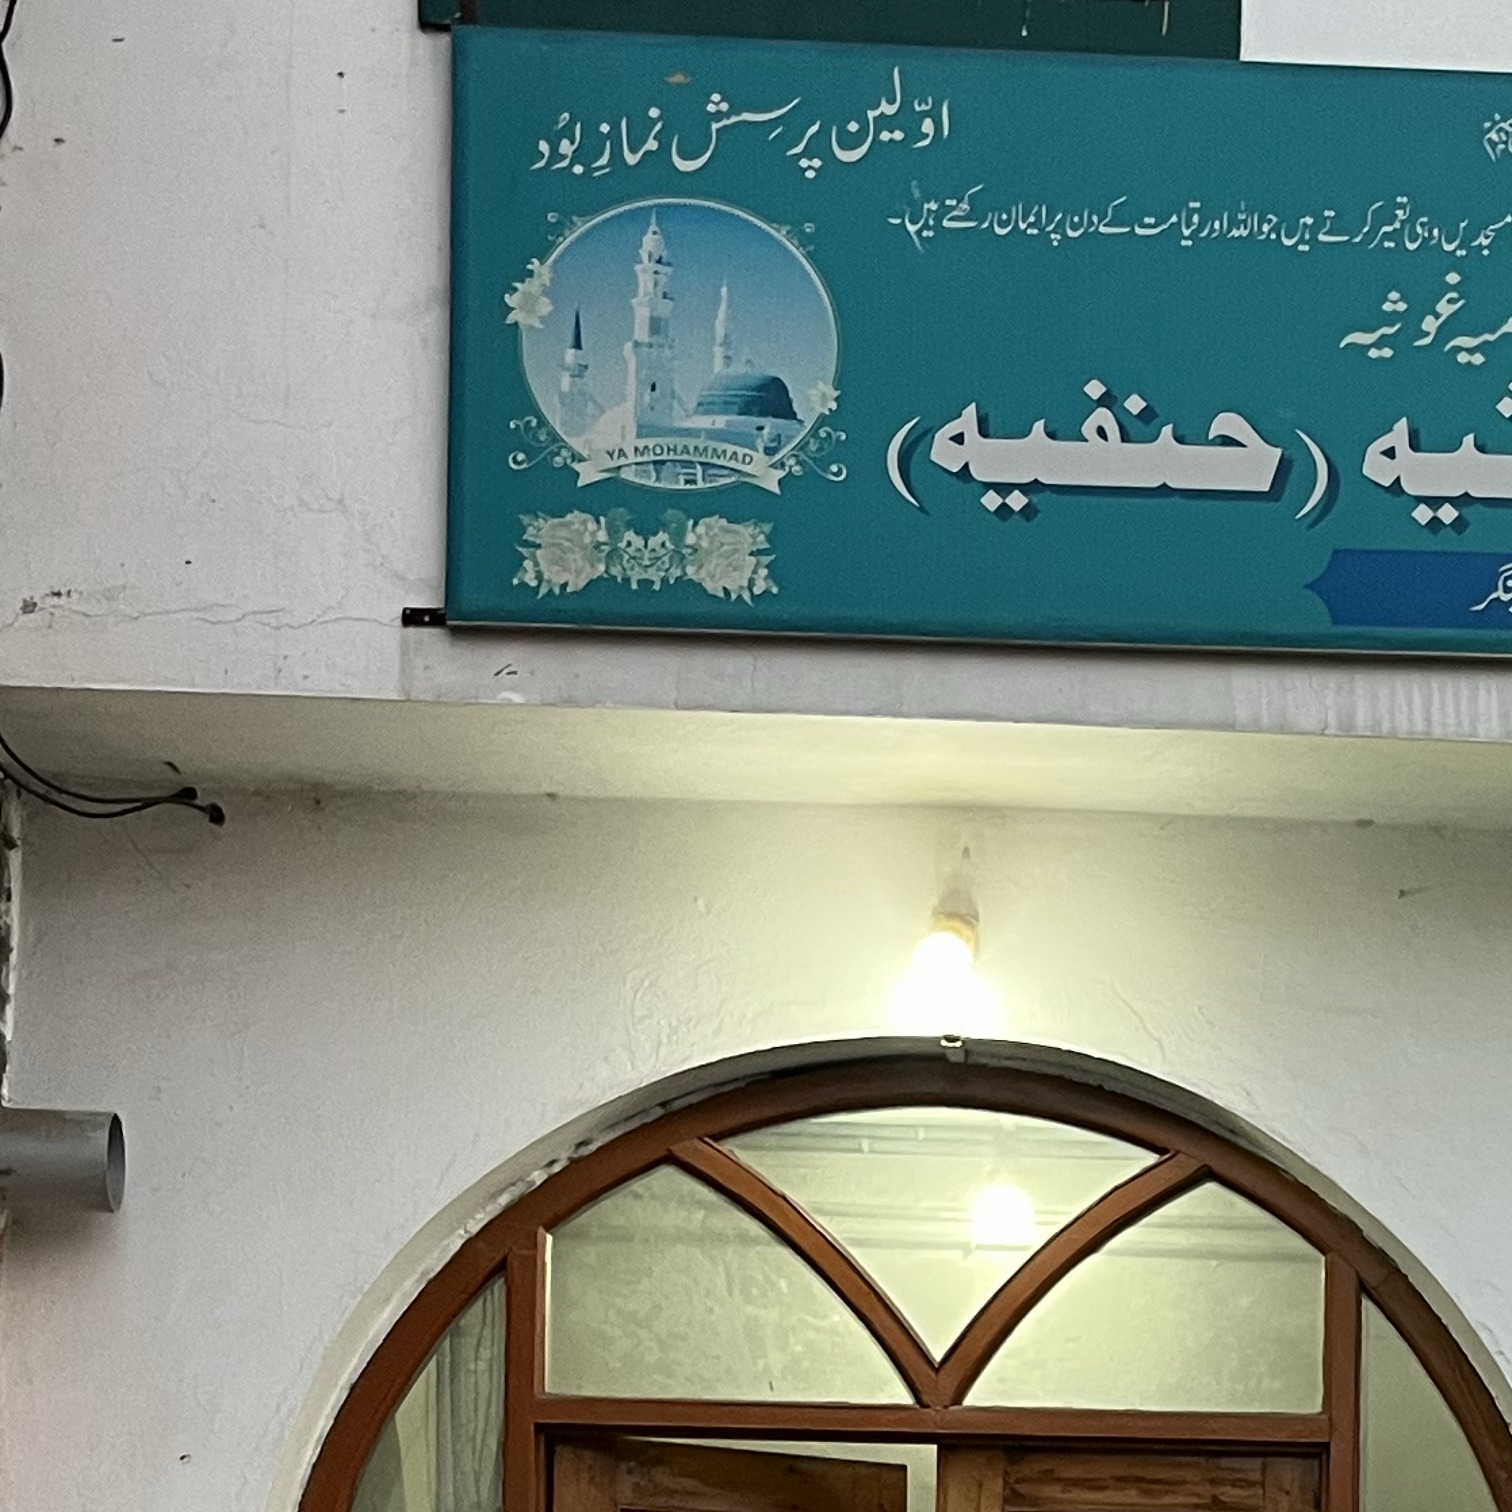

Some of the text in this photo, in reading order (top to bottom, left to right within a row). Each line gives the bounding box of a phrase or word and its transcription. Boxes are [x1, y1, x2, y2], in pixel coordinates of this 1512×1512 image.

[993, 202, 1047, 236] ایمان
[1045, 211, 1063, 248] پر
[1065, 208, 1099, 238] دن
[1097, 195, 1132, 235] کے
[1134, 201, 1201, 248] قیامت
[1199, 211, 1228, 240] اور
[1257, 214, 1278, 240] جو
[1280, 215, 1314, 252] ہیں
[1368, 195, 1411, 251] تعمیر
[1339, 272, 1467, 360] غوثیہ
[605, 443, 755, 466] YA MOHAMMAD
